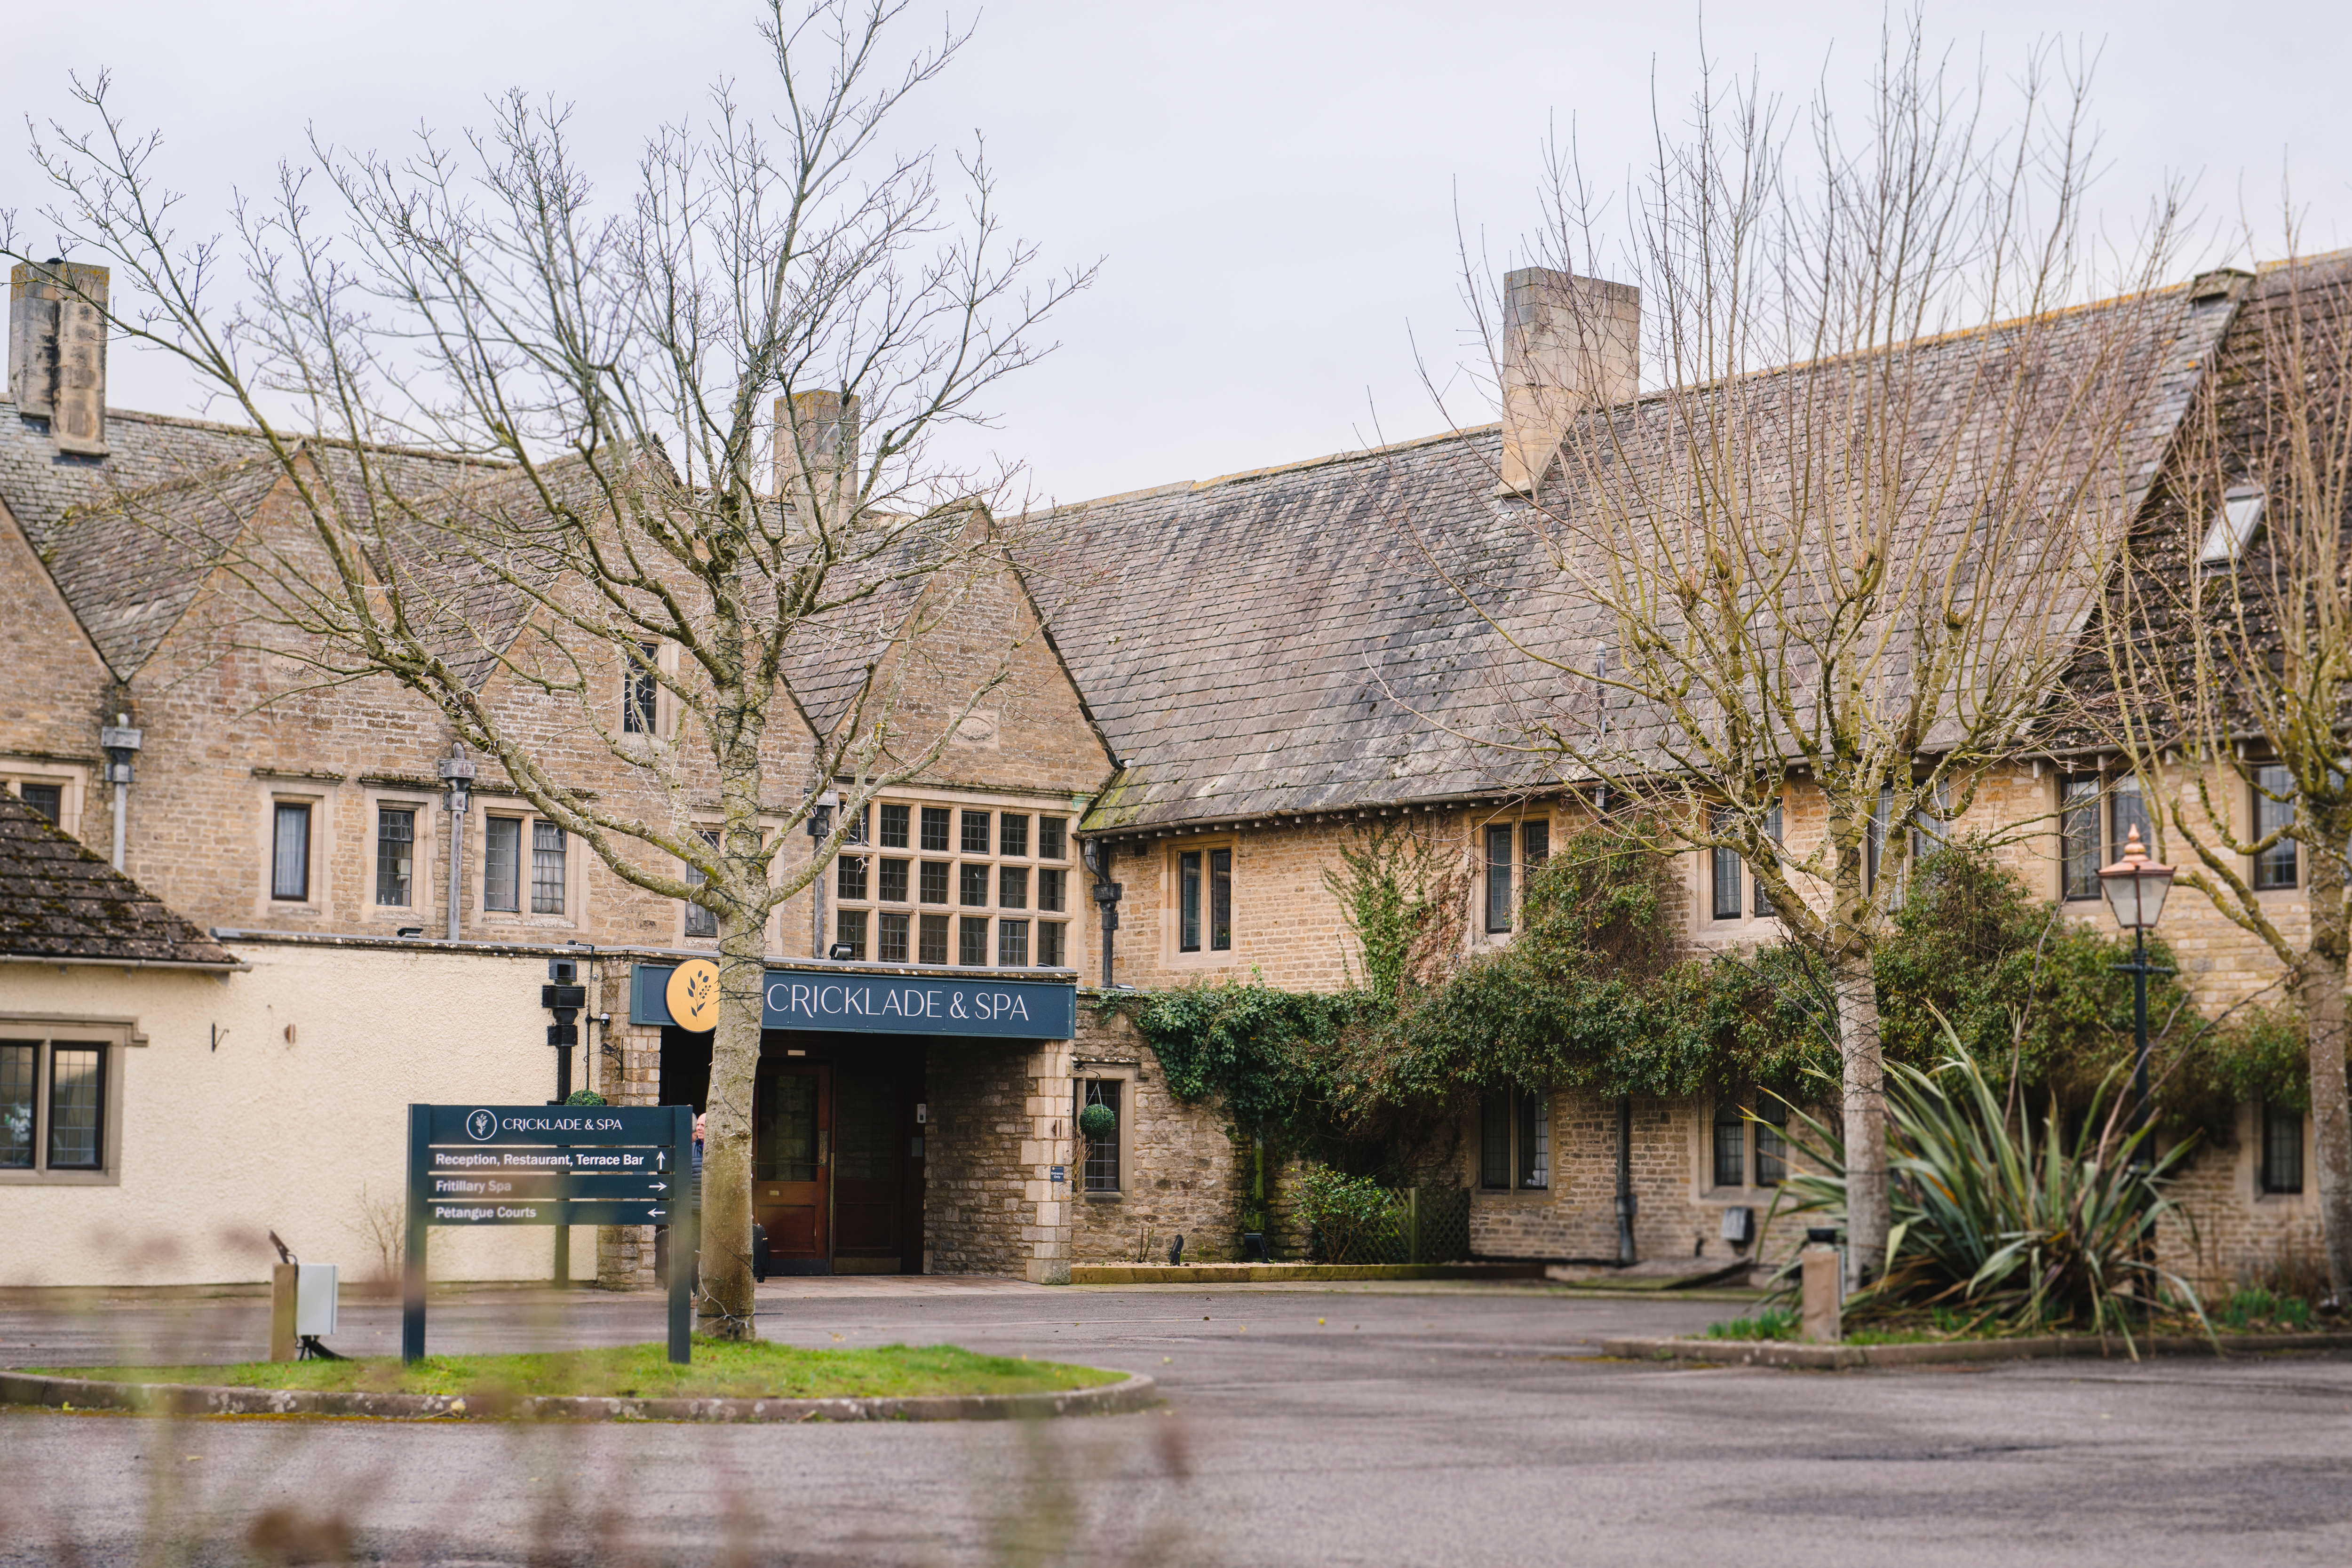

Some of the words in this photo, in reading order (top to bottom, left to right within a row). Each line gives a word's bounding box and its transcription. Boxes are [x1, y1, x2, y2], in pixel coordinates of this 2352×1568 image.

[767, 984, 942, 1018] CRICKLADE
[950, 992, 969, 1019] &
[975, 993, 1029, 1021] SPA
[502, 1118, 582, 1131] CRICKLADE
[585, 1119, 595, 1130] &
[597, 1119, 622, 1130] SPA
[436, 1154, 500, 1167] Reception,
[504, 1154, 573, 1167] Restaurant,
[576, 1154, 620, 1165] Terrace
[623, 1154, 644, 1165] Bar
[436, 1180, 485, 1194] Fritillary
[488, 1180, 511, 1193] Spa
[497, 1206, 537, 1218] Courts
